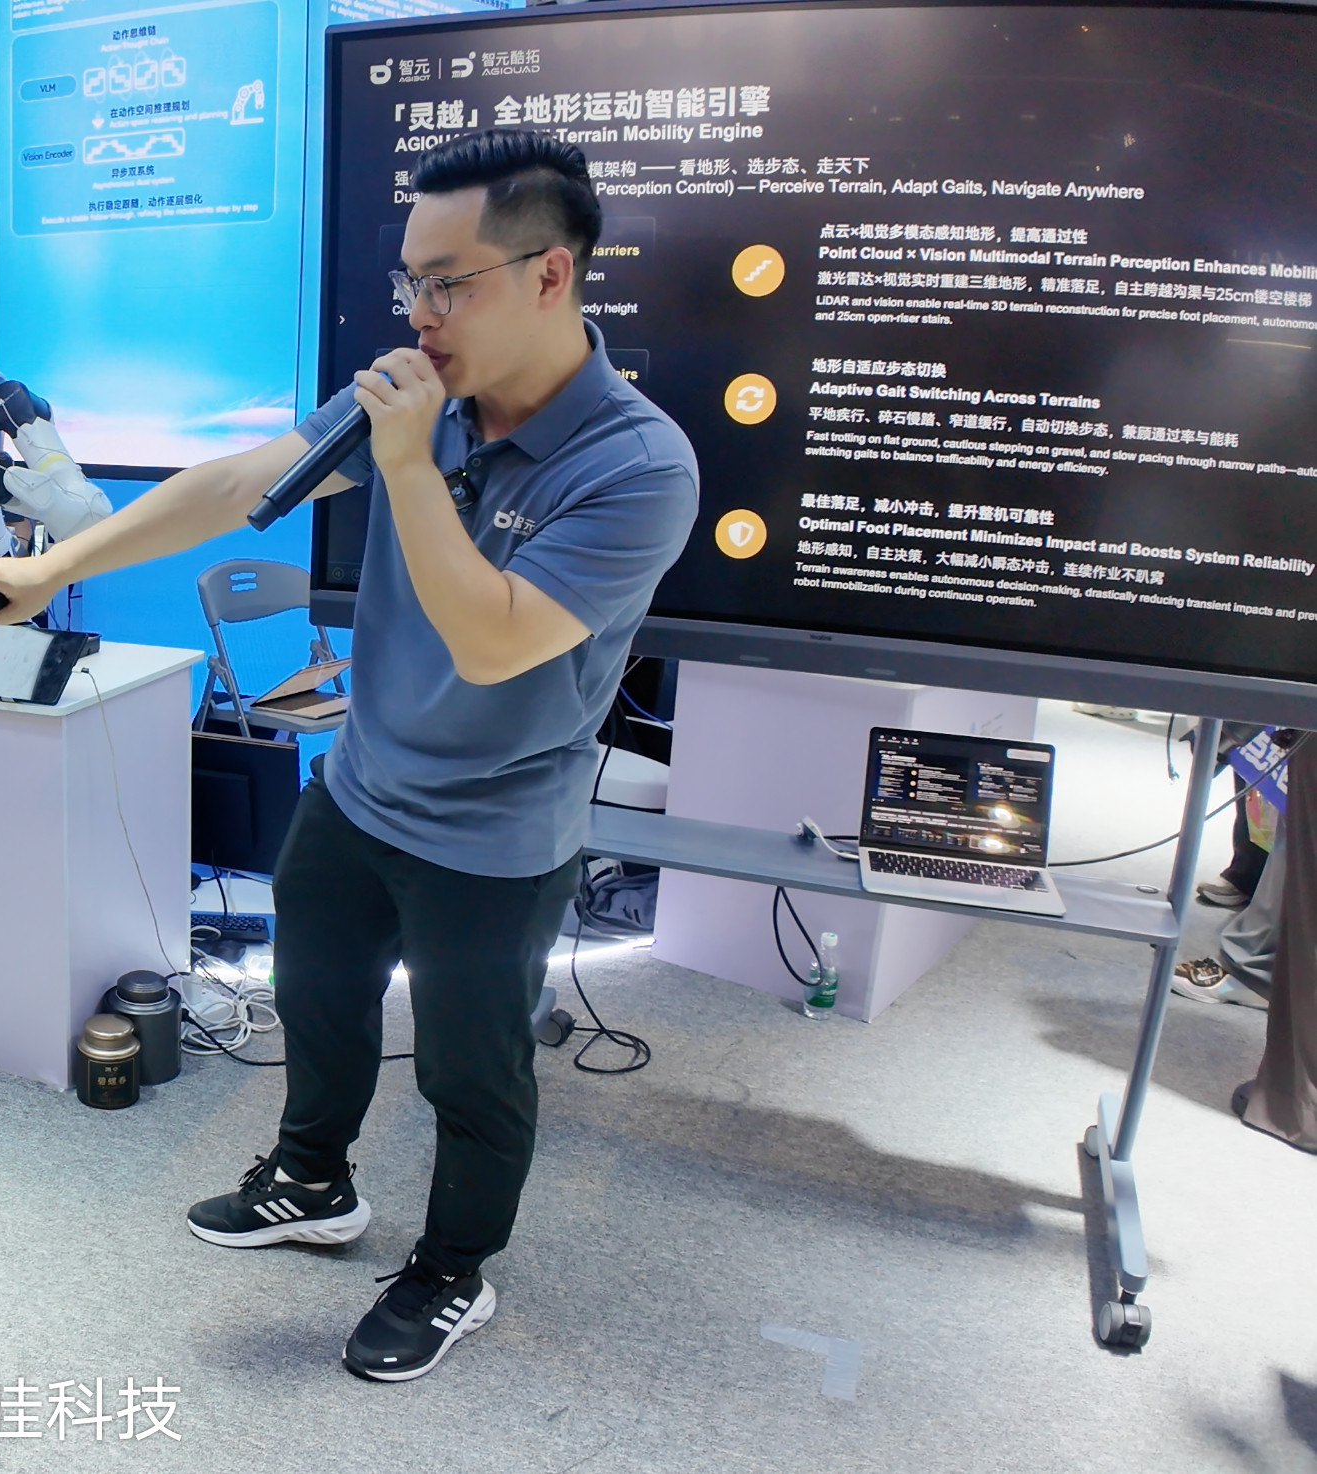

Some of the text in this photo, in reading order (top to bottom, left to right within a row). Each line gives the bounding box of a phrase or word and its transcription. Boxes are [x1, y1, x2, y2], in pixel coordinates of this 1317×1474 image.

[112, 25, 156, 41] 动作思维链
[399, 58, 430, 76] 智元
[481, 49, 541, 67] 智元酷拓
[399, 74, 431, 83] AGIBOT
[482, 65, 541, 77] AGIQUAD
[40, 83, 56, 94] VLM
[623, 123, 763, 143] Mobility Engine
[45, 149, 73, 160] Encoder
[111, 165, 155, 178] 异步双系统
[679, 156, 870, 176] 看地形、选步态、走天下
[596, 181, 672, 197] Perception
[676, 179, 734, 197] Control)
[759, 180, 824, 194] Perceive
[829, 179, 887, 195] Terrain,
[891, 179, 938, 197] Adapt
[942, 179, 987, 197] Gaits,
[991, 180, 1062, 199] Navigate
[1065, 181, 1145, 201] Anywhere
[819, 246, 857, 259] Point
[860, 246, 903, 260] Cloud
[920, 247, 966, 262] Vision
[970, 249, 1051, 265] Multimodal
[1054, 252, 1106, 267] Terrain
[1111, 254, 1191, 272] Perception
[1194, 259, 1267, 276] Enhances
[605, 303, 639, 316] height
[815, 311, 953, 325] and 25cm open-riser stairs.
[816, 295, 849, 306] LiDAR
[852, 296, 871, 307] and
[874, 296, 904, 308] vision
[906, 297, 941, 309] enable
[943, 299, 989, 311] real-time
[991, 300, 1008, 311] 3D
[1009, 301, 1043, 313] terrain
[1046, 303, 1120, 316] reconstruction
[1122, 306, 1136, 318] for
[1138, 308, 1178, 321] precise
[1179, 309, 1201, 321] foot
[1202, 311, 1260, 327] placement,
[812, 358, 947, 379] 地形自适应步态切换
[809, 381, 1101, 409] Adaptive Gait Switching Across Terrains
[806, 430, 829, 441] Fast
[831, 431, 866, 445] trotting
[868, 435, 881, 444] on
[883, 434, 900, 446] flat
[901, 436, 941, 449] ground,
[943, 438, 987, 451] cautious
[989, 441, 1033, 456] stepping
[1035, 445, 1049, 455] on
[1051, 446, 1088, 460] gravel,
[1089, 448, 1110, 460] and
[1112, 449, 1137, 461] slow
[1138, 452, 1174, 467] pacing
[1176, 454, 1216, 470] through
[1218, 459, 1255, 471] narrow
[805, 446, 1109, 477] switching gaits to balance trafficability and energy efficiency.
[798, 516, 1315, 576] Optimal Foot Placement Minimizes Impact and Boosts System Reliability
[793, 576, 1038, 608] robot immobilization during continuous operation.
[795, 562, 830, 574] Terrain
[832, 566, 887, 579] awareness
[889, 569, 929, 583] enables
[931, 574, 995, 588] autonomous
[1085, 587, 1138, 603] drastically
[1139, 592, 1184, 608] reducing
[1186, 597, 1232, 612] transient
[1233, 602, 1273, 617] impacts
[1275, 607, 1295, 619] and
